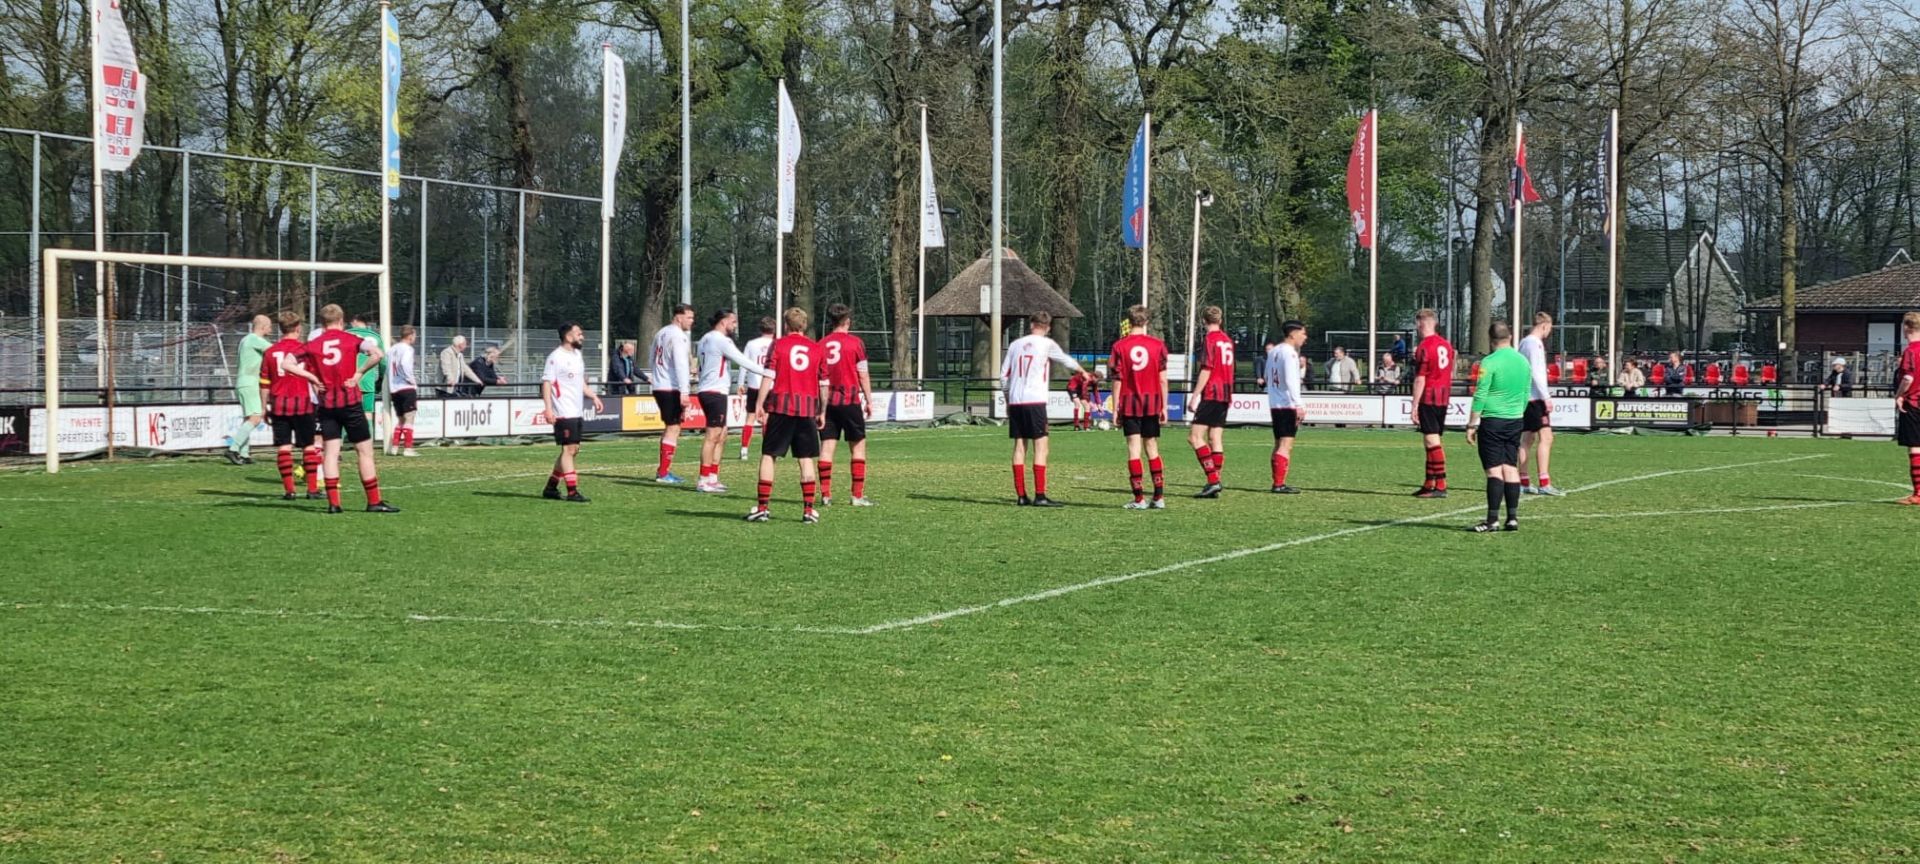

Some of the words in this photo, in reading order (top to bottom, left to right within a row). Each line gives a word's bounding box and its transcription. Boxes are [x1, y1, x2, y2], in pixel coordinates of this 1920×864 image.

[322, 339, 342, 366] 5
[789, 345, 810, 371] 6
[825, 341, 842, 365] 3
[1129, 346, 1149, 371] 9
[1437, 345, 1449, 369] 8
[1019, 354, 1034, 378] 17
[454, 402, 492, 431] nijhof
[1617, 403, 1688, 412] AUTOSCHADE
[70, 418, 103, 427] TWENTE
[57, 432, 93, 443] OPERTIES
